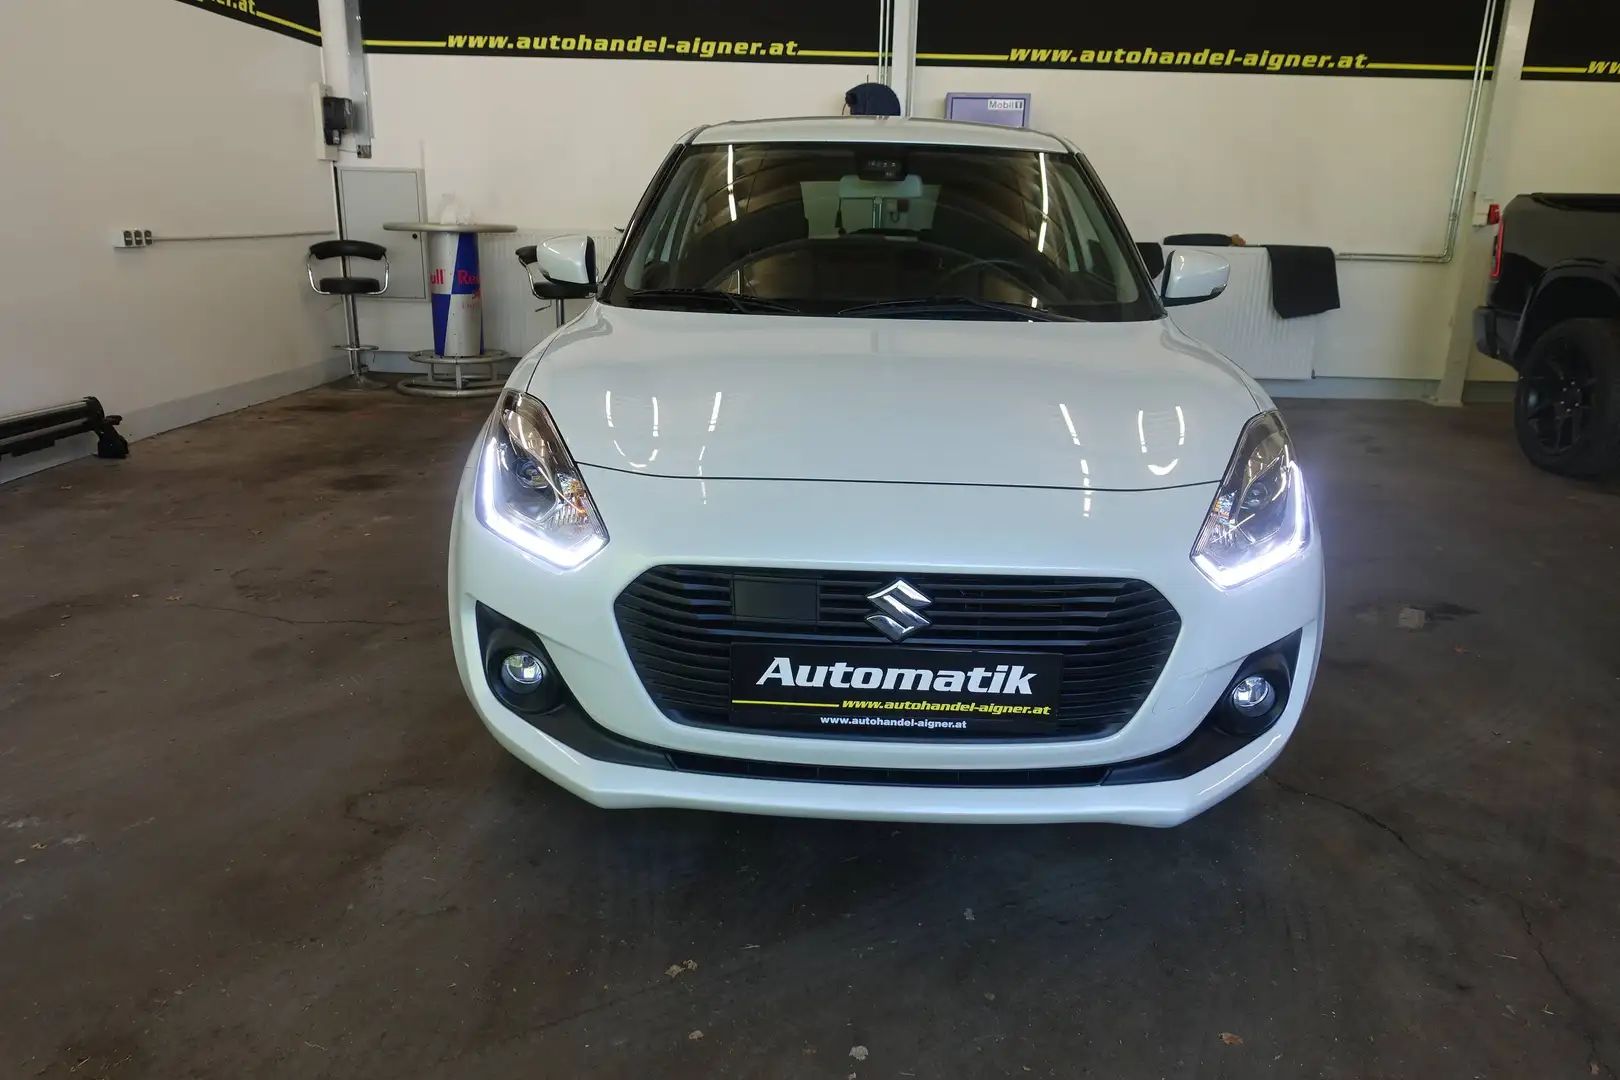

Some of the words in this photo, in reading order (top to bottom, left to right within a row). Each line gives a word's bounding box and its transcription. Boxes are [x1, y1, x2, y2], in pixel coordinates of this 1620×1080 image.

[448, 35, 797, 57] www.autohandel-aigner.at
[1009, 48, 1368, 70] www.autohandel-aigner.at
[756, 657, 1037, 694] Automatik
[842, 700, 1051, 715] www.autohandel-aigner.at
[820, 716, 968, 729] www.autohandel-aigner.at
